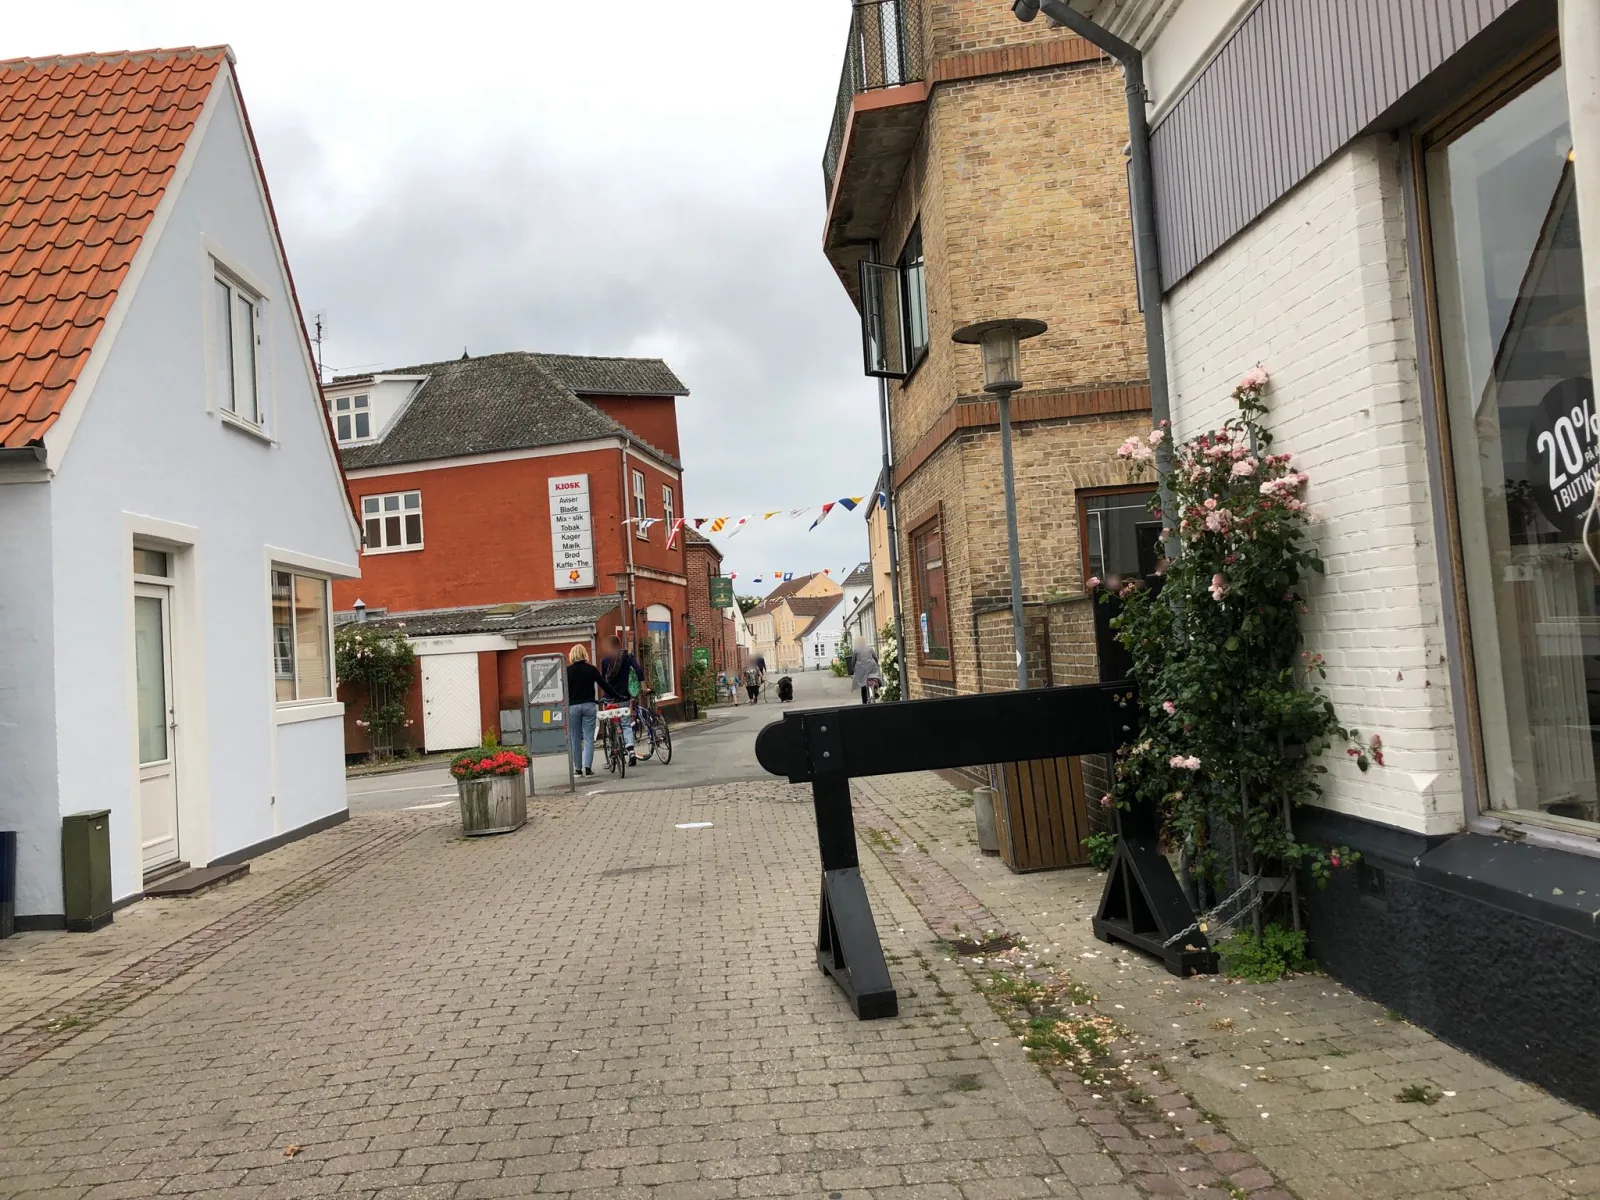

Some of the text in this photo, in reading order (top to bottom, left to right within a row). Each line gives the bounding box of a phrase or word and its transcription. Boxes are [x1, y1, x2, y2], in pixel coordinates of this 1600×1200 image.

[1537, 398, 1600, 490] 20%
[1584, 445, 1595, 463] PÅ
[555, 481, 580, 490] KIOSK
[560, 505, 578, 513] Blade
[1553, 494, 1562, 512] I
